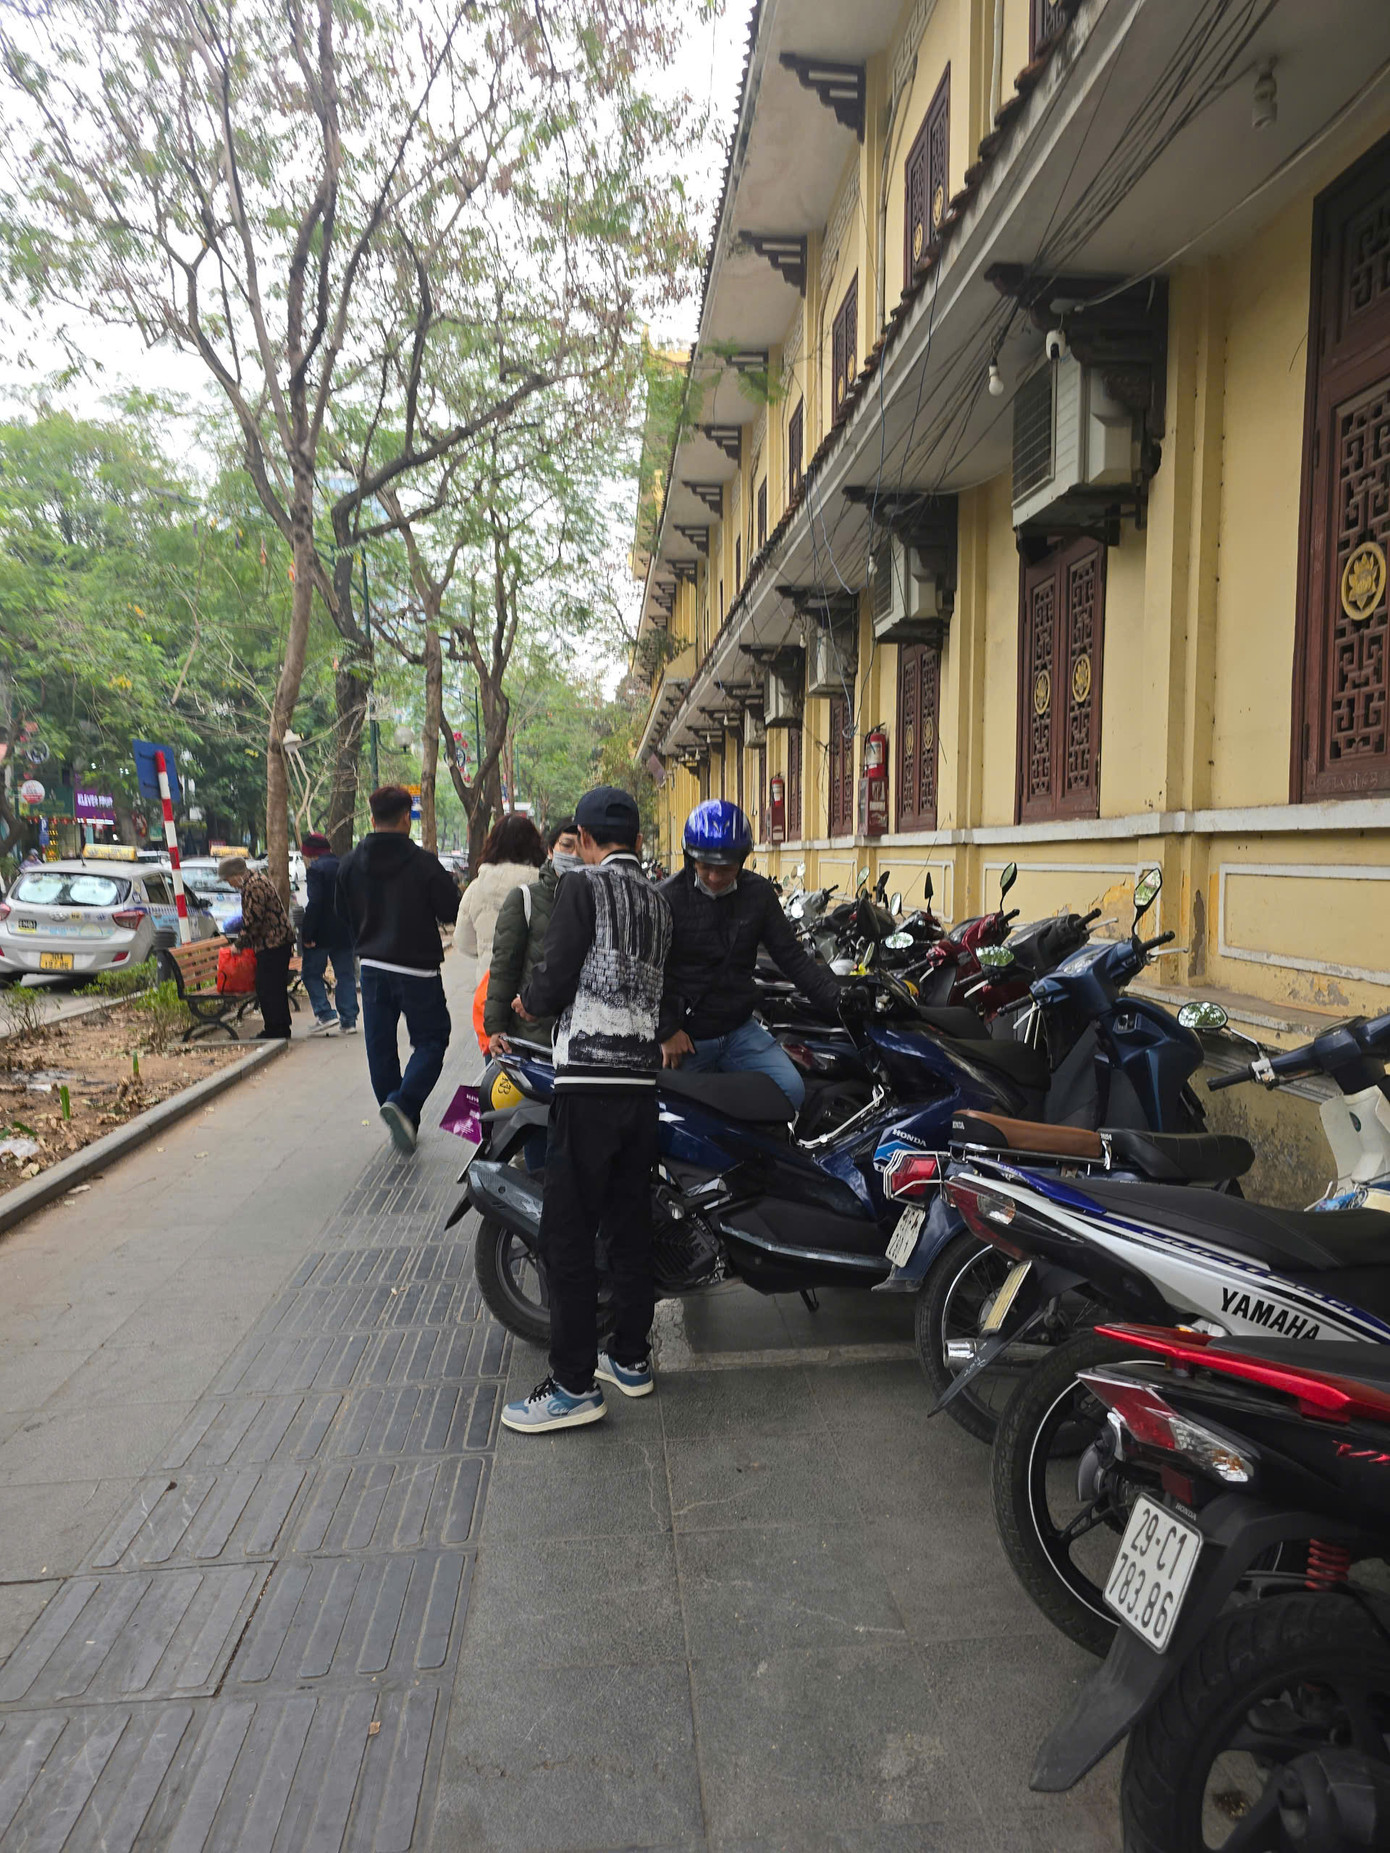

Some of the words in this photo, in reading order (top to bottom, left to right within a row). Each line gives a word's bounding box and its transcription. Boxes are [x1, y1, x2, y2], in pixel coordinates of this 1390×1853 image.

[892, 1129, 927, 1147] HONDA
[1221, 1287, 1320, 1340] YAMAHA
[1175, 1502, 1197, 1521] HONDA
[1130, 1508, 1188, 1580] 29-C1
[1109, 1553, 1174, 1640] 783.86
